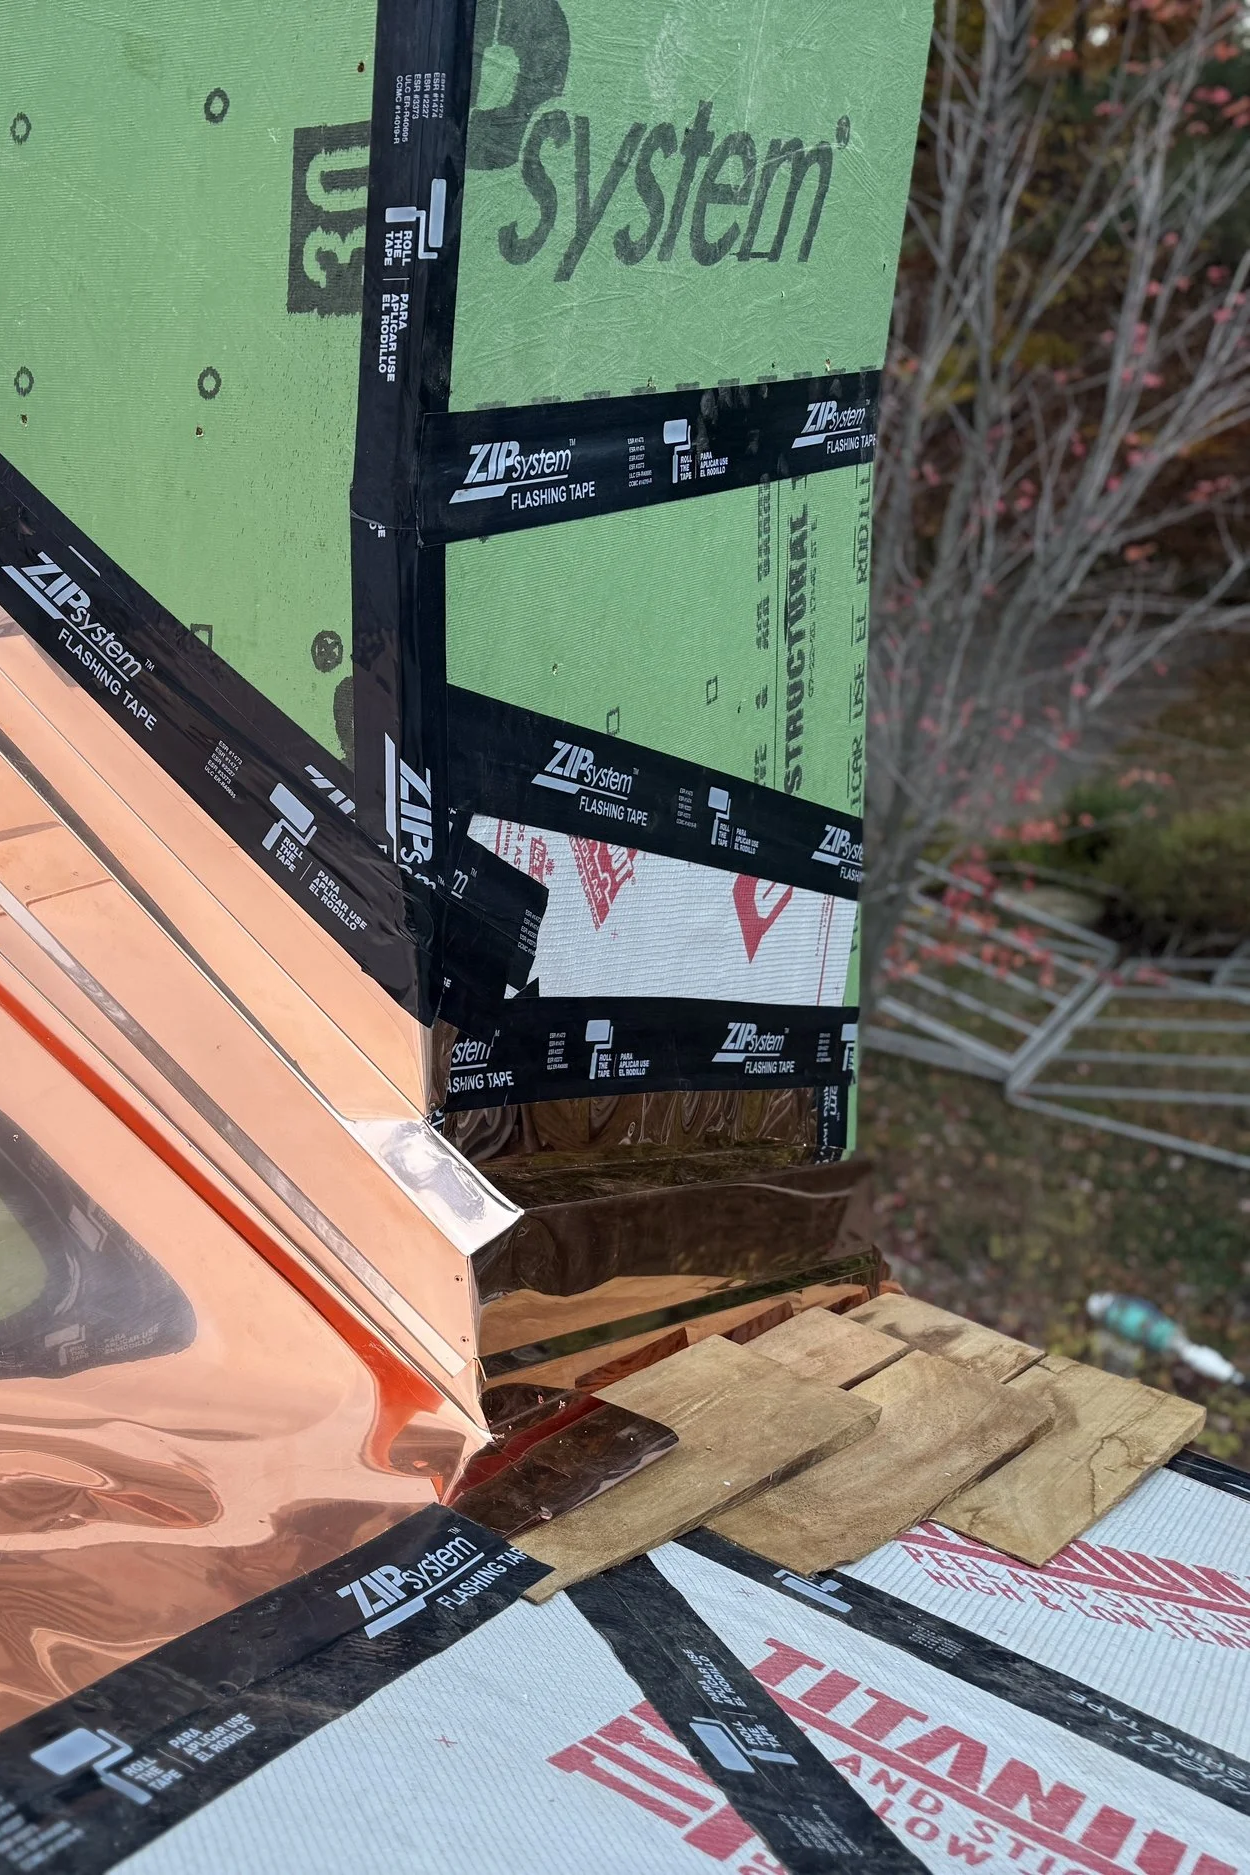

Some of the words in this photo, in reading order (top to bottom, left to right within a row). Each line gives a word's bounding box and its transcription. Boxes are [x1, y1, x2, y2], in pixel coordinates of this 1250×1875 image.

[395, 75, 404, 103] CCMC
[404, 74, 413, 94] ULC
[413, 73, 422, 92] ESR
[423, 73, 432, 92] ESR
[384, 230, 394, 266] TAPE
[393, 230, 403, 258] THE
[402, 230, 413, 267] ROLL
[381, 294, 390, 311] EL
[398, 293, 409, 330] PARA
[388, 293, 400, 352] APLICAR
[378, 315, 389, 373] RODILLO
[386, 355, 397, 382] USE
[700, 451, 713, 461] PARA
[826, 436, 860, 455] FLASHING
[680, 455, 693, 464] ROLL
[680, 464, 690, 473] THE
[700, 458, 719, 470] APLICAR
[719, 456, 729, 465] USE
[680, 472, 693, 481] TAPE
[700, 470, 707, 478] EL
[706, 466, 726, 477] RODILLO
[511, 484, 567, 511] FLASHING
[569, 481, 596, 500] TAPE
[784, 503, 808, 795] STRUCTURAL
[58, 628, 122, 696] FLASHING
[122, 690, 157, 732] TAPE
[579, 796, 625, 821] FLASHING
[626, 807, 649, 827] TAPE
[736, 827, 747, 837] PARA
[279, 843, 297, 863] THE
[283, 836, 303, 861] ROLL
[275, 850, 296, 873] TAPE
[317, 869, 341, 895] PARA
[308, 883, 320, 897] EL
[320, 894, 358, 931] RODILLO
[312, 877, 349, 913] APLICAR
[349, 909, 368, 931] USE
[598, 1061, 609, 1070] THE
[599, 1053, 612, 1062] ROLL
[619, 1060, 639, 1069] APLICAR
[639, 1059, 650, 1068] USE
[620, 1052, 634, 1061] PARA
[745, 1061, 778, 1074] FLASHING
[778, 1061, 796, 1073] TAPE
[486, 1070, 514, 1089] TAPE
[598, 1069, 611, 1078] TAPE
[619, 1069, 626, 1077] EL
[625, 1068, 646, 1077] RODILLO
[435, 1561, 508, 1611] FLASHING
[901, 1544, 1000, 1580] PEEL
[1006, 1568, 1088, 1601] AND
[1092, 1588, 1209, 1626] STICK
[923, 1567, 1026, 1604] HIGH
[1032, 1590, 1068, 1613] &
[1069, 1599, 1155, 1633] LOW
[682, 1648, 703, 1666] USE
[697, 1667, 737, 1706] APLICAR
[698, 1655, 737, 1695] RODILLO
[697, 1680, 724, 1704] PARA
[732, 1696, 748, 1708] EL
[1067, 1690, 1141, 1733] TAPE
[167, 1727, 203, 1750] PARA
[181, 1725, 224, 1757] APLICAR
[219, 1712, 251, 1735] USE
[195, 1746, 213, 1764] EL
[209, 1722, 257, 1755] RODILLO
[731, 1720, 759, 1746] ROLL
[746, 1726, 769, 1747] THE
[754, 1723, 783, 1749] TAPE
[121, 1755, 157, 1778] ROLL
[134, 1765, 165, 1784] THE
[148, 1769, 184, 1792] TAPE
[832, 1753, 945, 1816] AND
[874, 1798, 996, 1868] LOW
